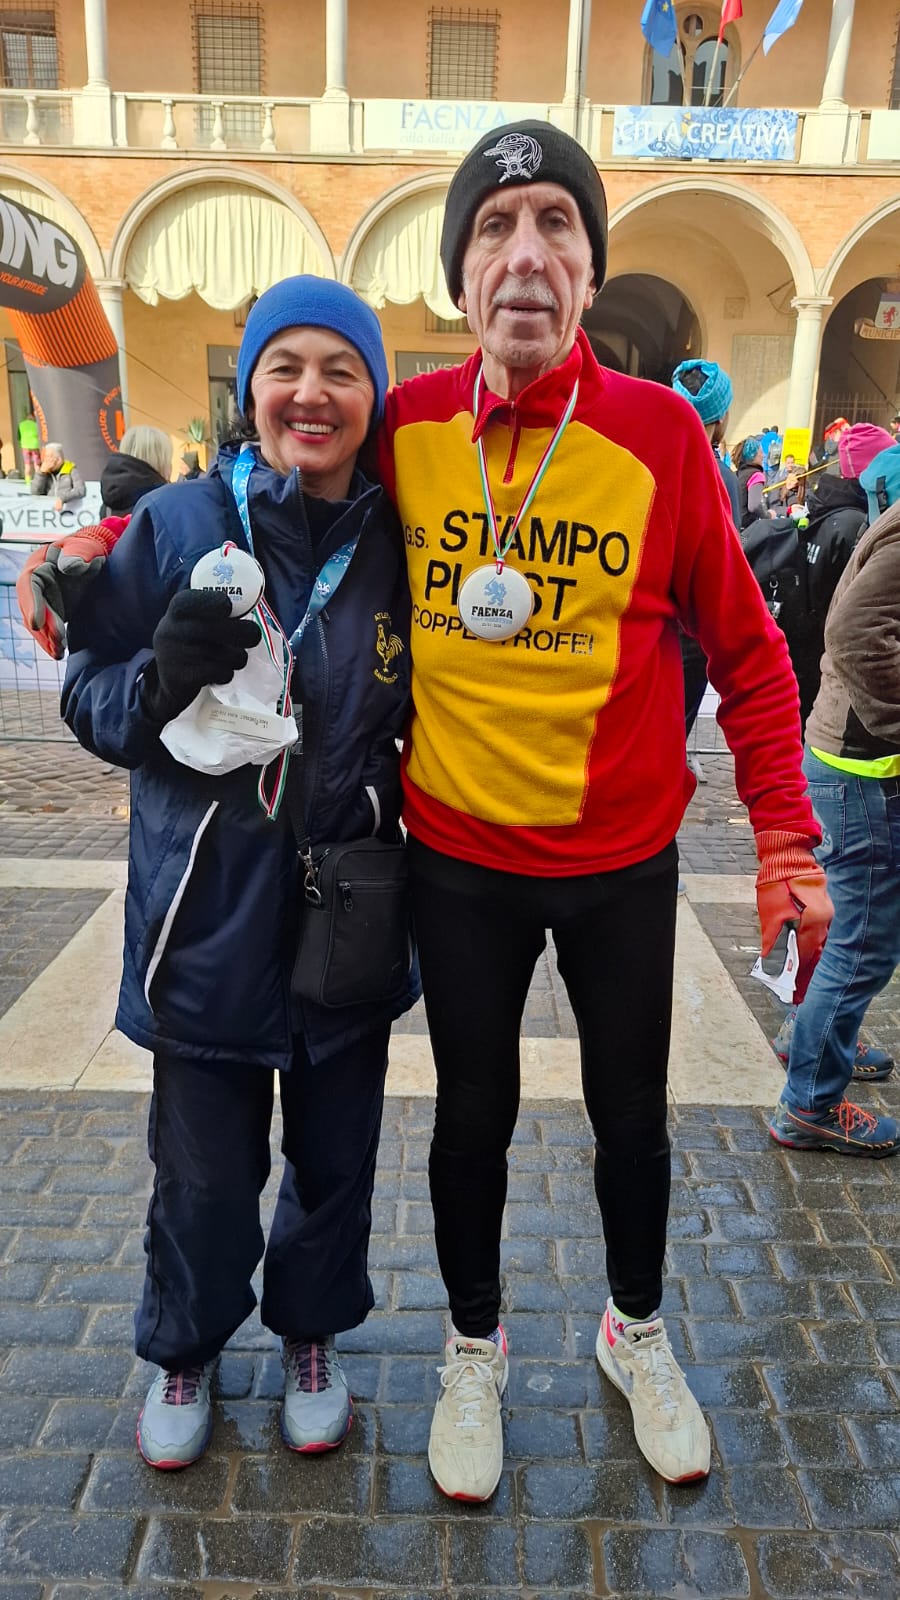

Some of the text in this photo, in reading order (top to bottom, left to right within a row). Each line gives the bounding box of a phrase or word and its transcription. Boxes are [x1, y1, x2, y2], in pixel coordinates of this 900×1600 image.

[687, 121, 790, 146] CREATIVA
[0, 510, 95, 528] VERCO
[405, 509, 630, 577] G.S. STAMPO
[471, 606, 513, 620] FAENZA
[501, 627, 594, 655] ROFEI
